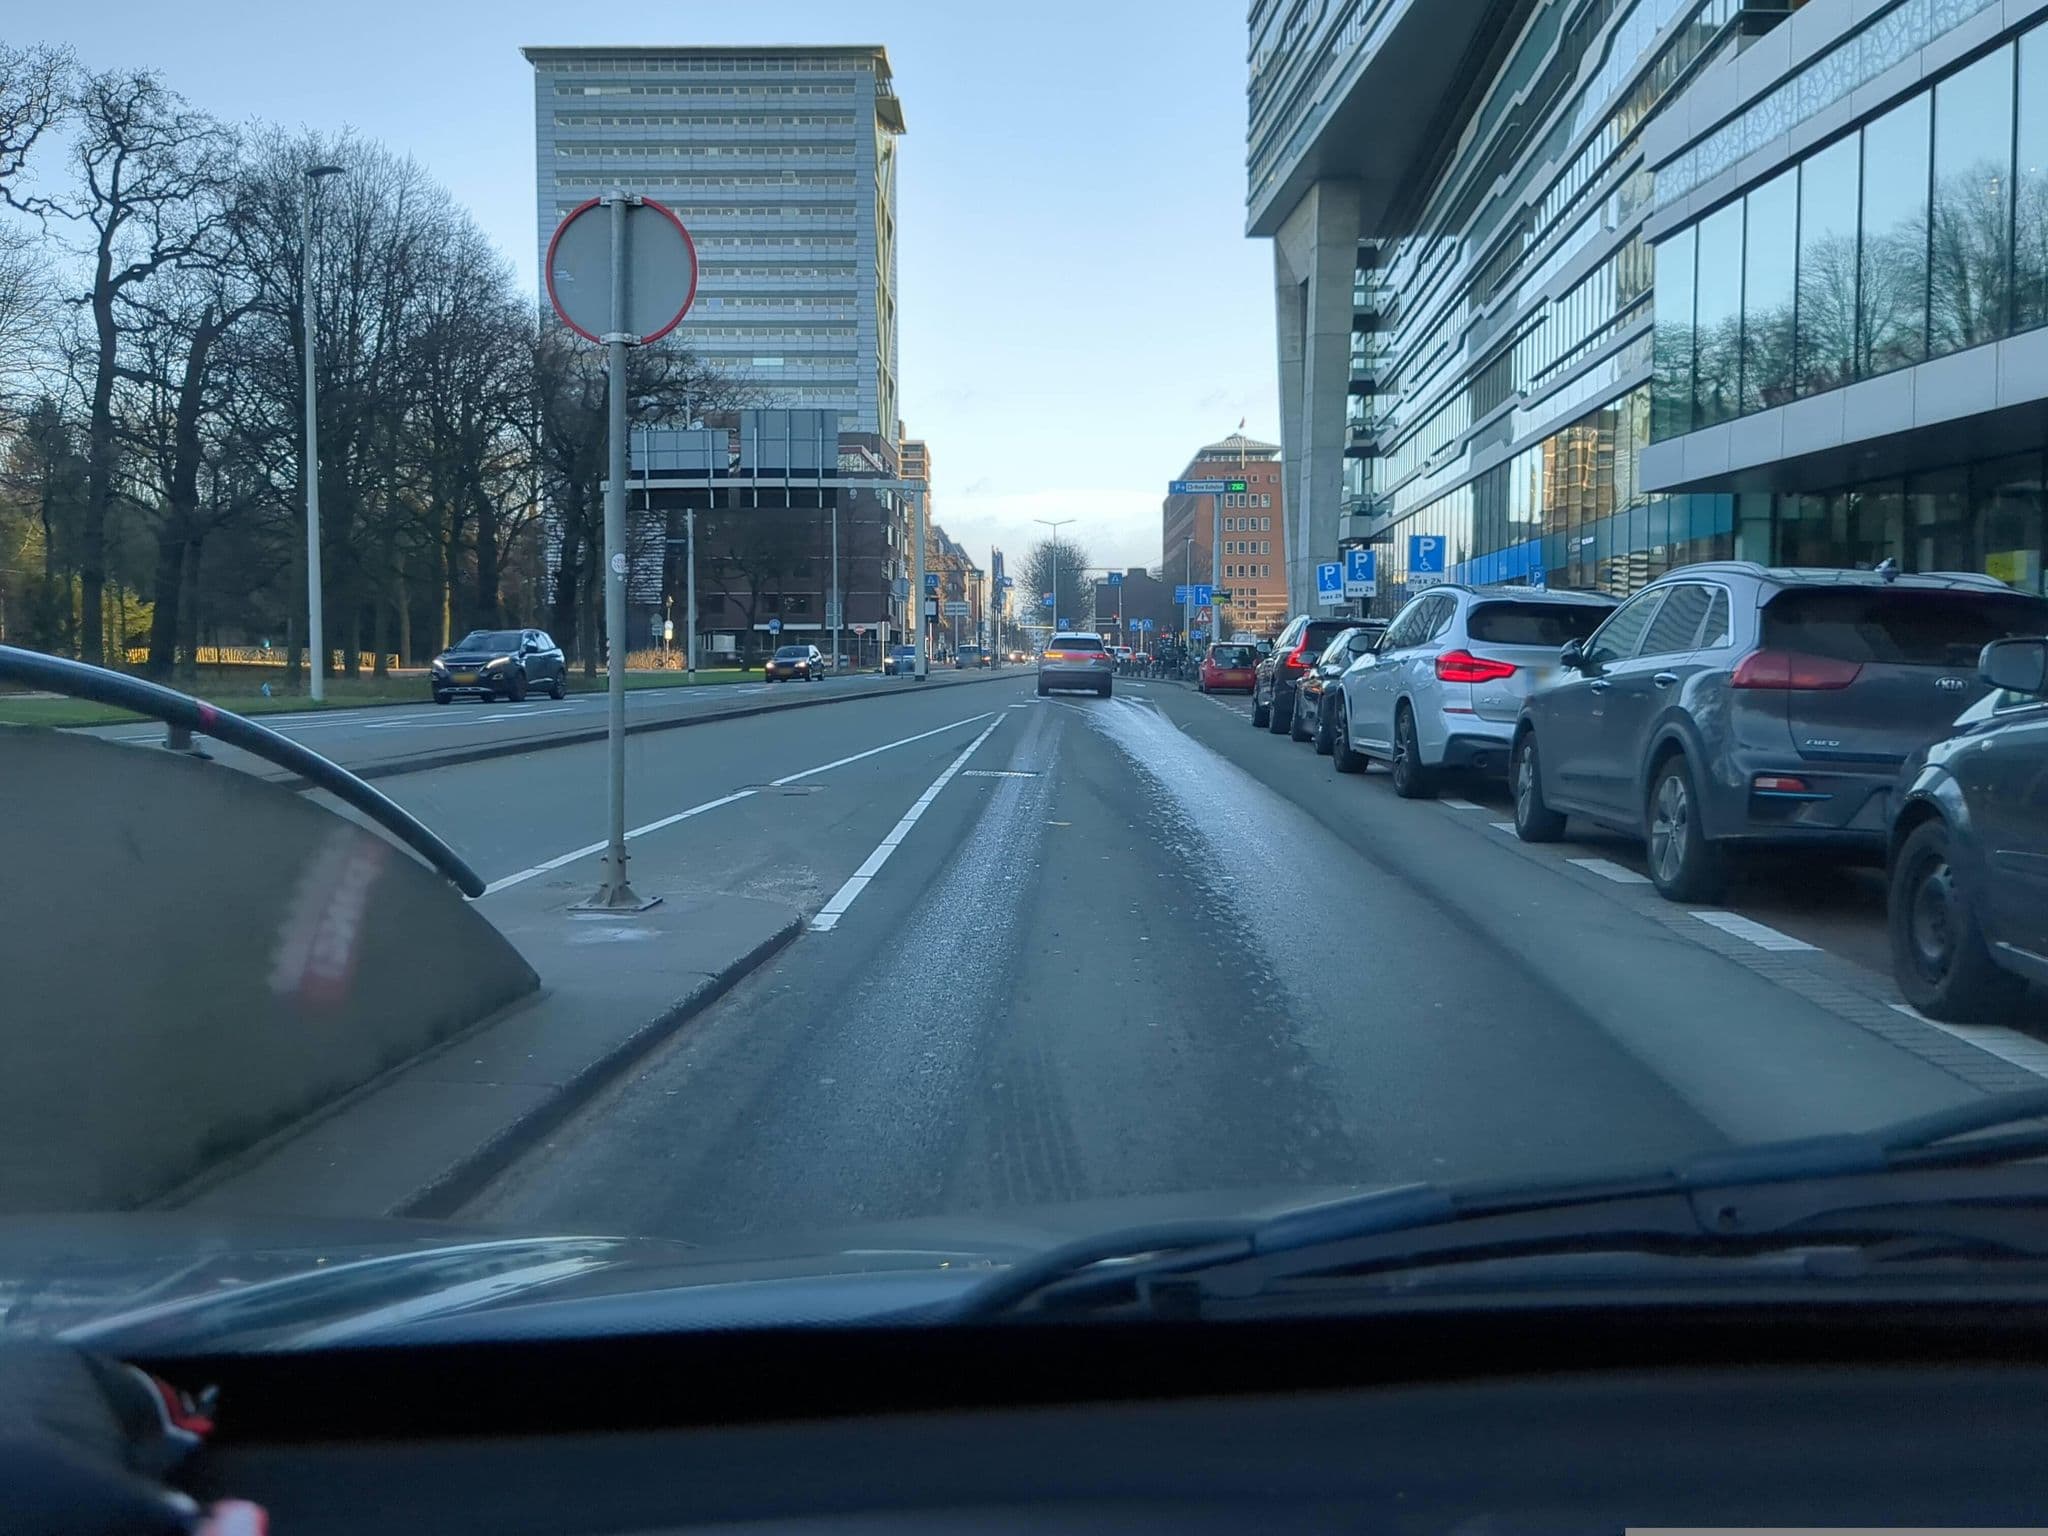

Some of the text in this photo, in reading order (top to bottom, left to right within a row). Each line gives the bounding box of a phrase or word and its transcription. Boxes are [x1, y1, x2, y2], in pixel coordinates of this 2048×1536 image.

[1420, 538, 1436, 557] P
[1355, 553, 1367, 568] P
[1324, 566, 1335, 580] P
[1941, 679, 1963, 688] KIA
